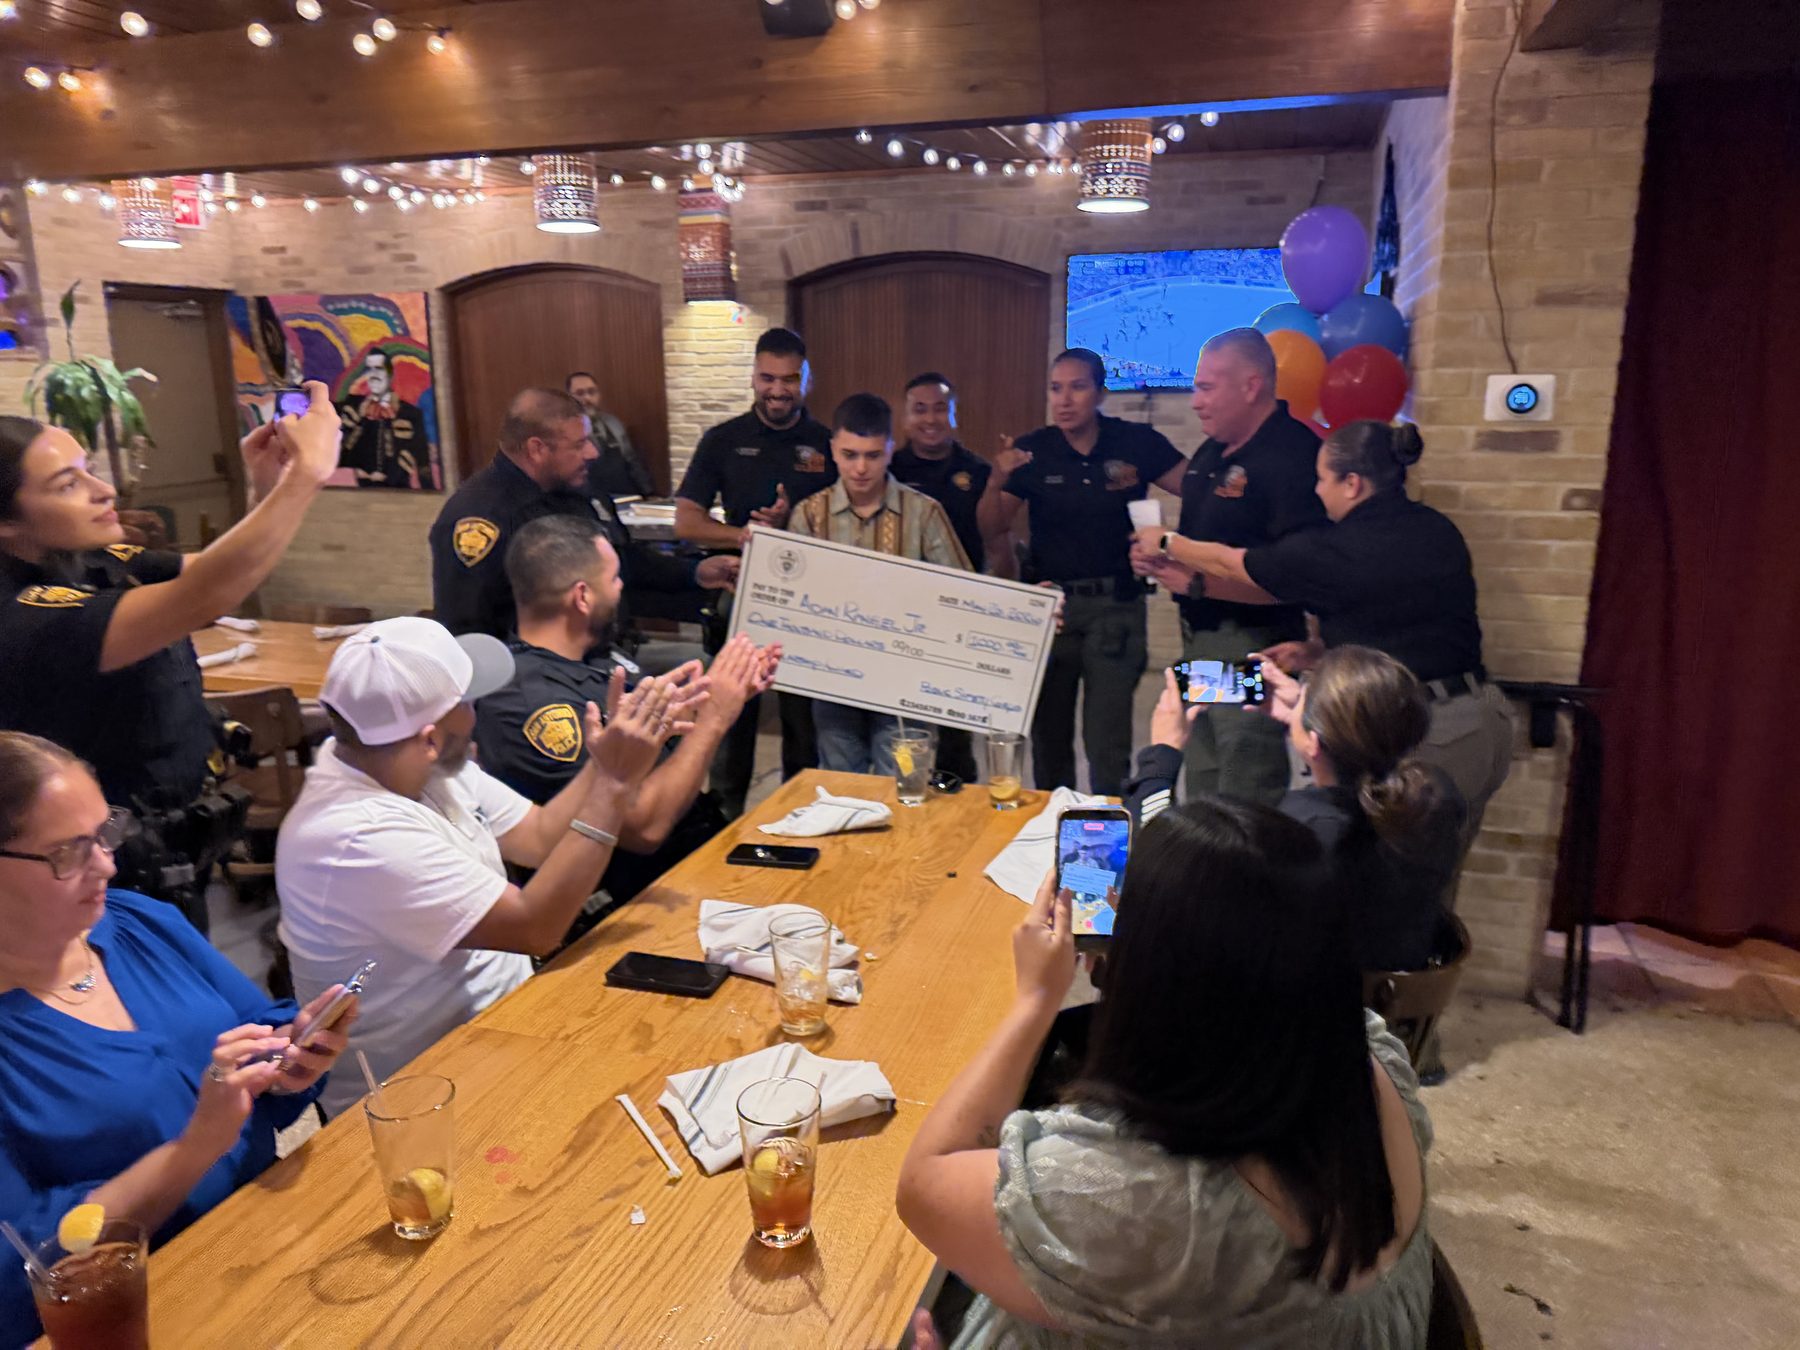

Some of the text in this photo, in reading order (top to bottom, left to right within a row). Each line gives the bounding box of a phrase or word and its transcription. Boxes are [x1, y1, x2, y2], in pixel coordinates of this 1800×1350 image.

[768, 585, 779, 593] TO
[939, 595, 958, 605] DATE
[976, 662, 1011, 675] DOLLARS
